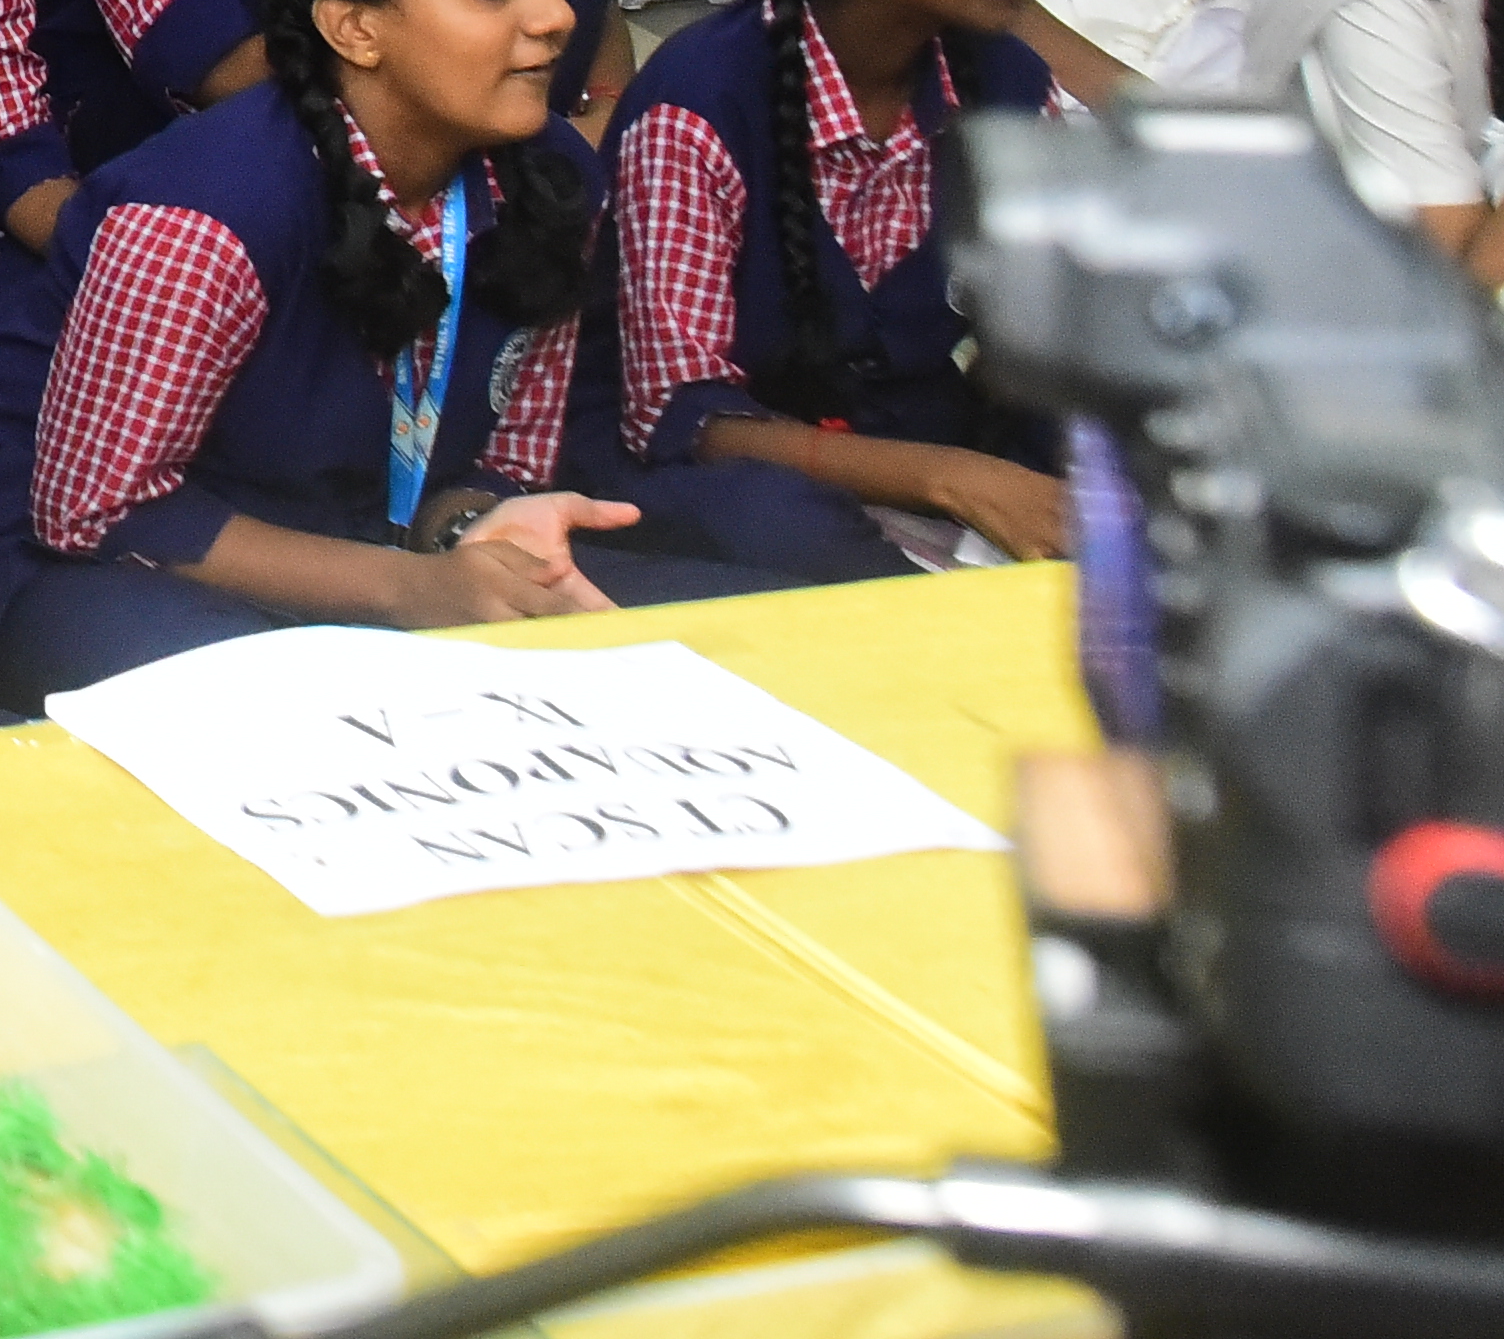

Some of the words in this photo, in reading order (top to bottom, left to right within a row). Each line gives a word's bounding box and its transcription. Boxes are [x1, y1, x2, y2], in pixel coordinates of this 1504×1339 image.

[337, 707, 397, 749] A
[478, 691, 585, 730] IX
[239, 742, 799, 834] AQUAPONICS
[408, 802, 662, 869] SCAN
[674, 793, 792, 838] CT
